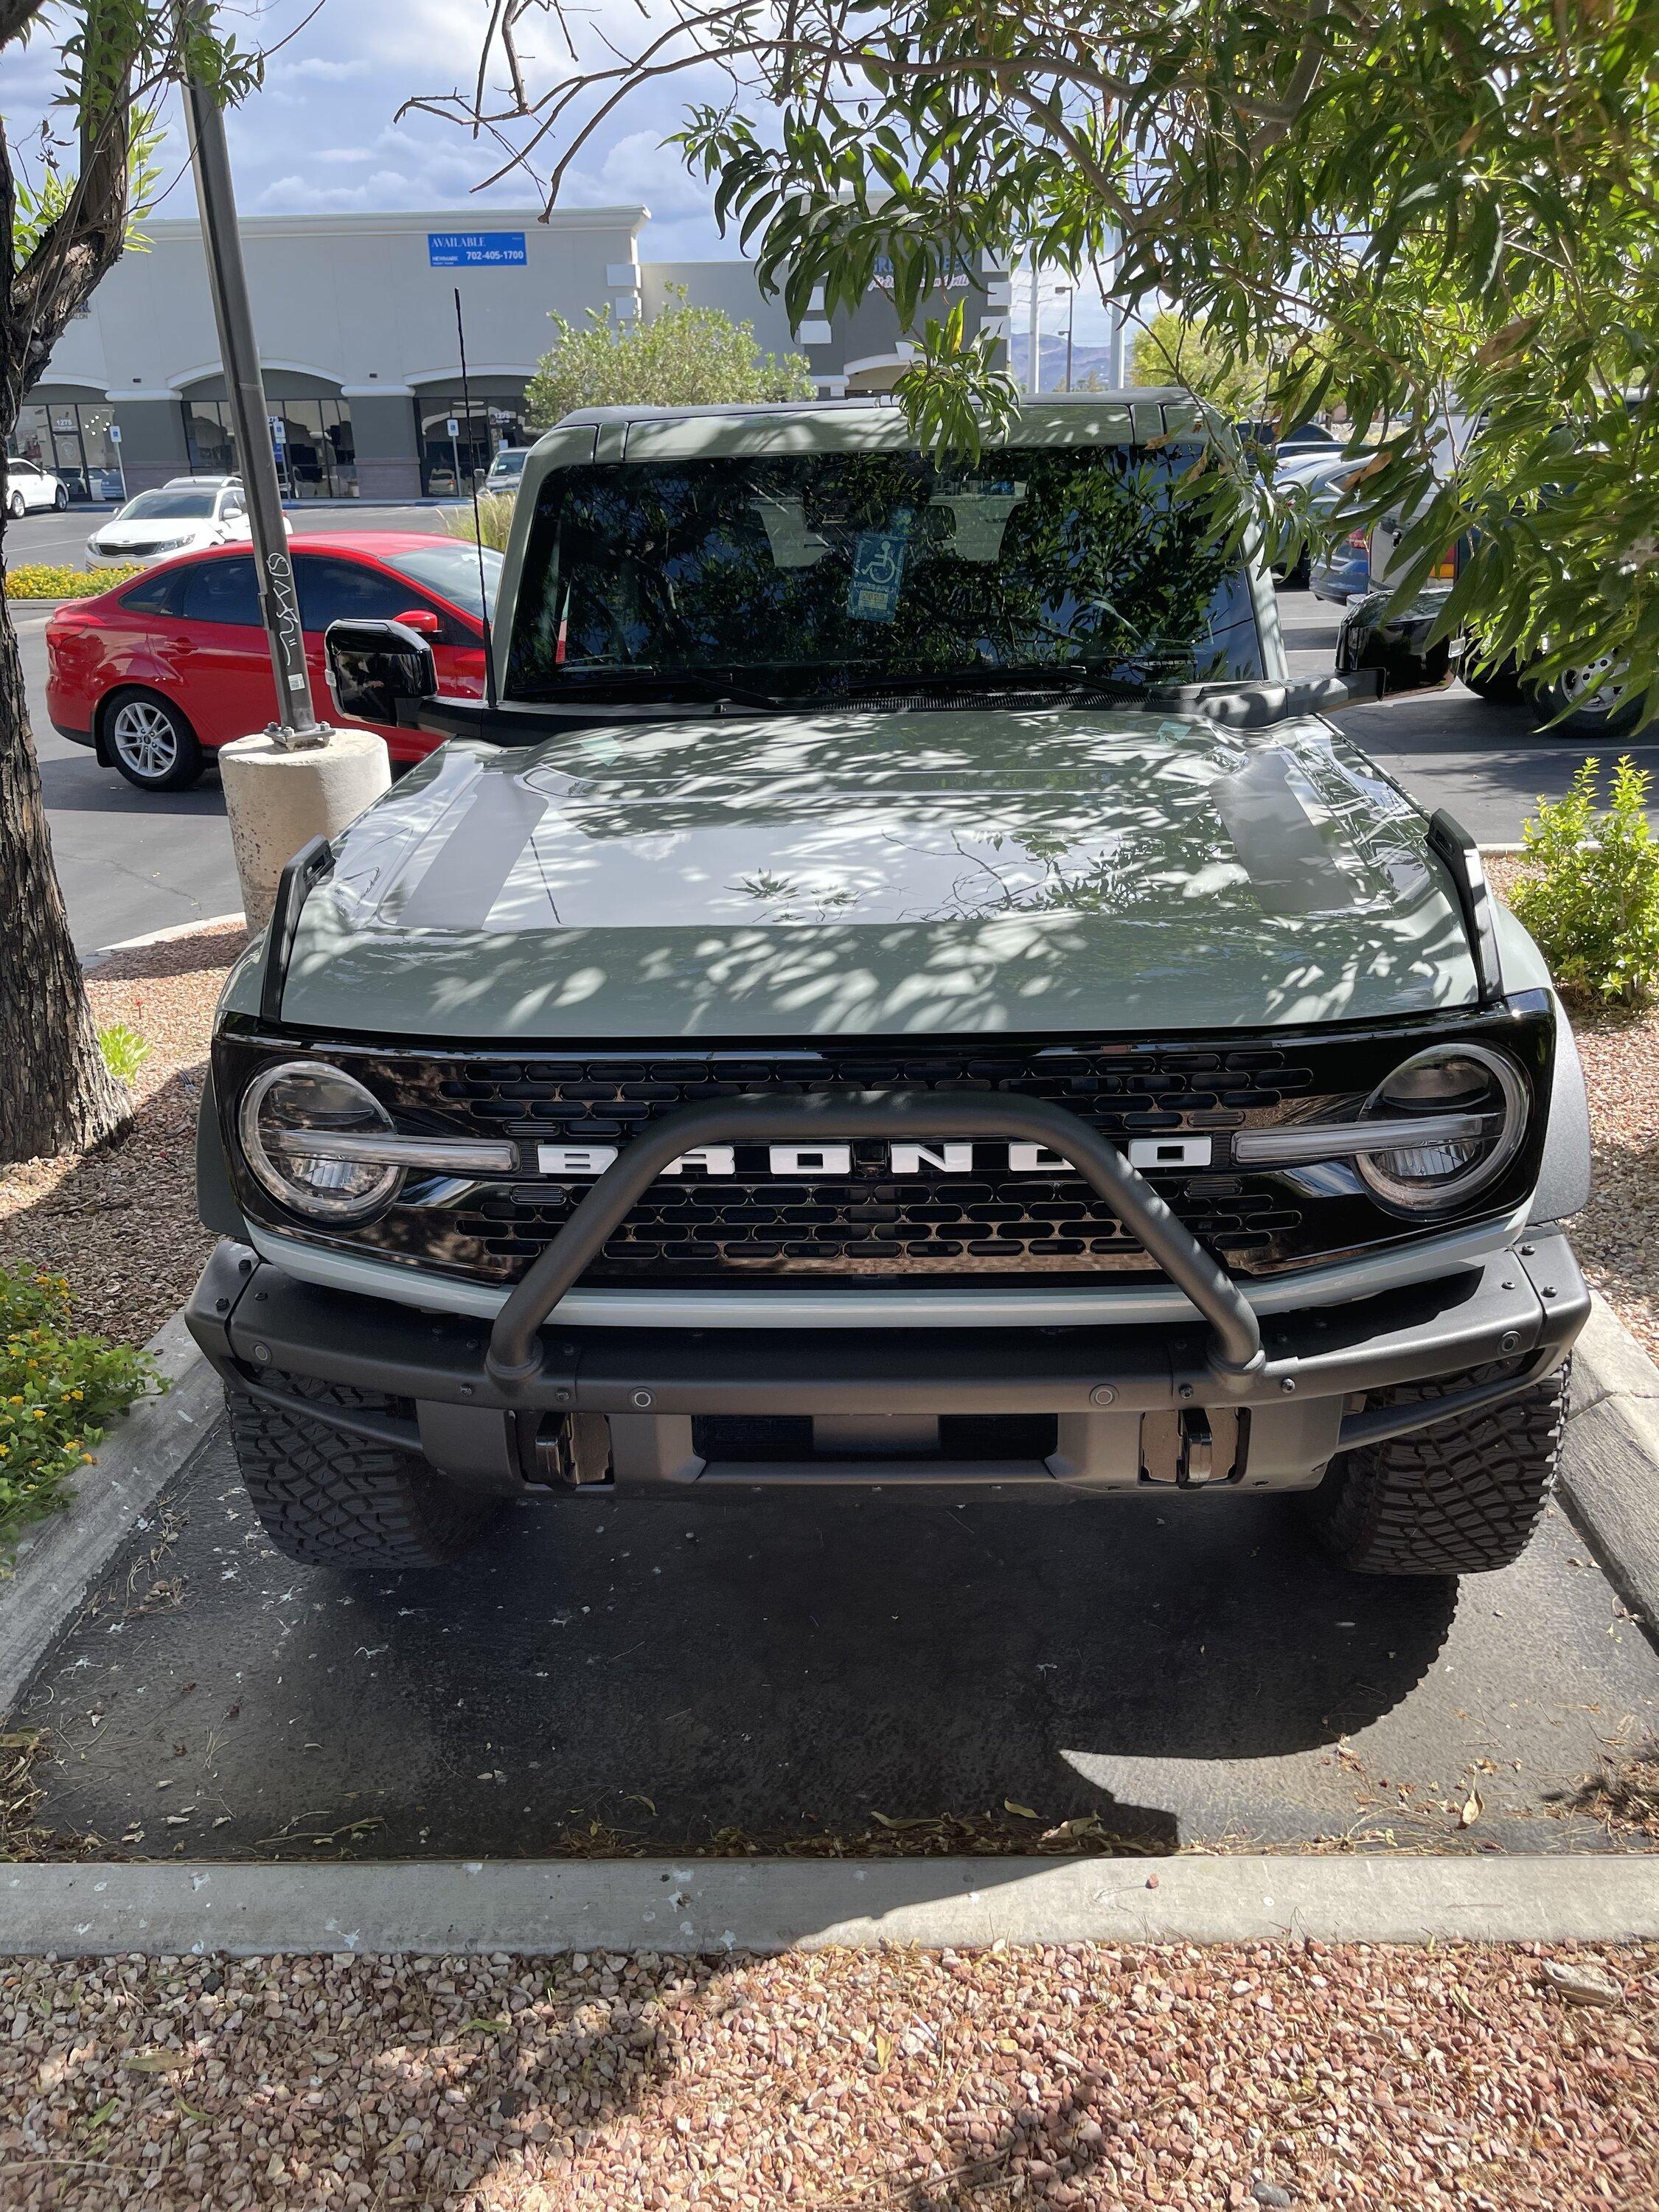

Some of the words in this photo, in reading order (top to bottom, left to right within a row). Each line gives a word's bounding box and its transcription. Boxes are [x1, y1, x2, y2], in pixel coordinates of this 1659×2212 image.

[431, 237, 487, 248] AVAILABLE
[466, 250, 524, 260] 702-405-1700
[538, 1136, 1211, 1175] BRONCO
